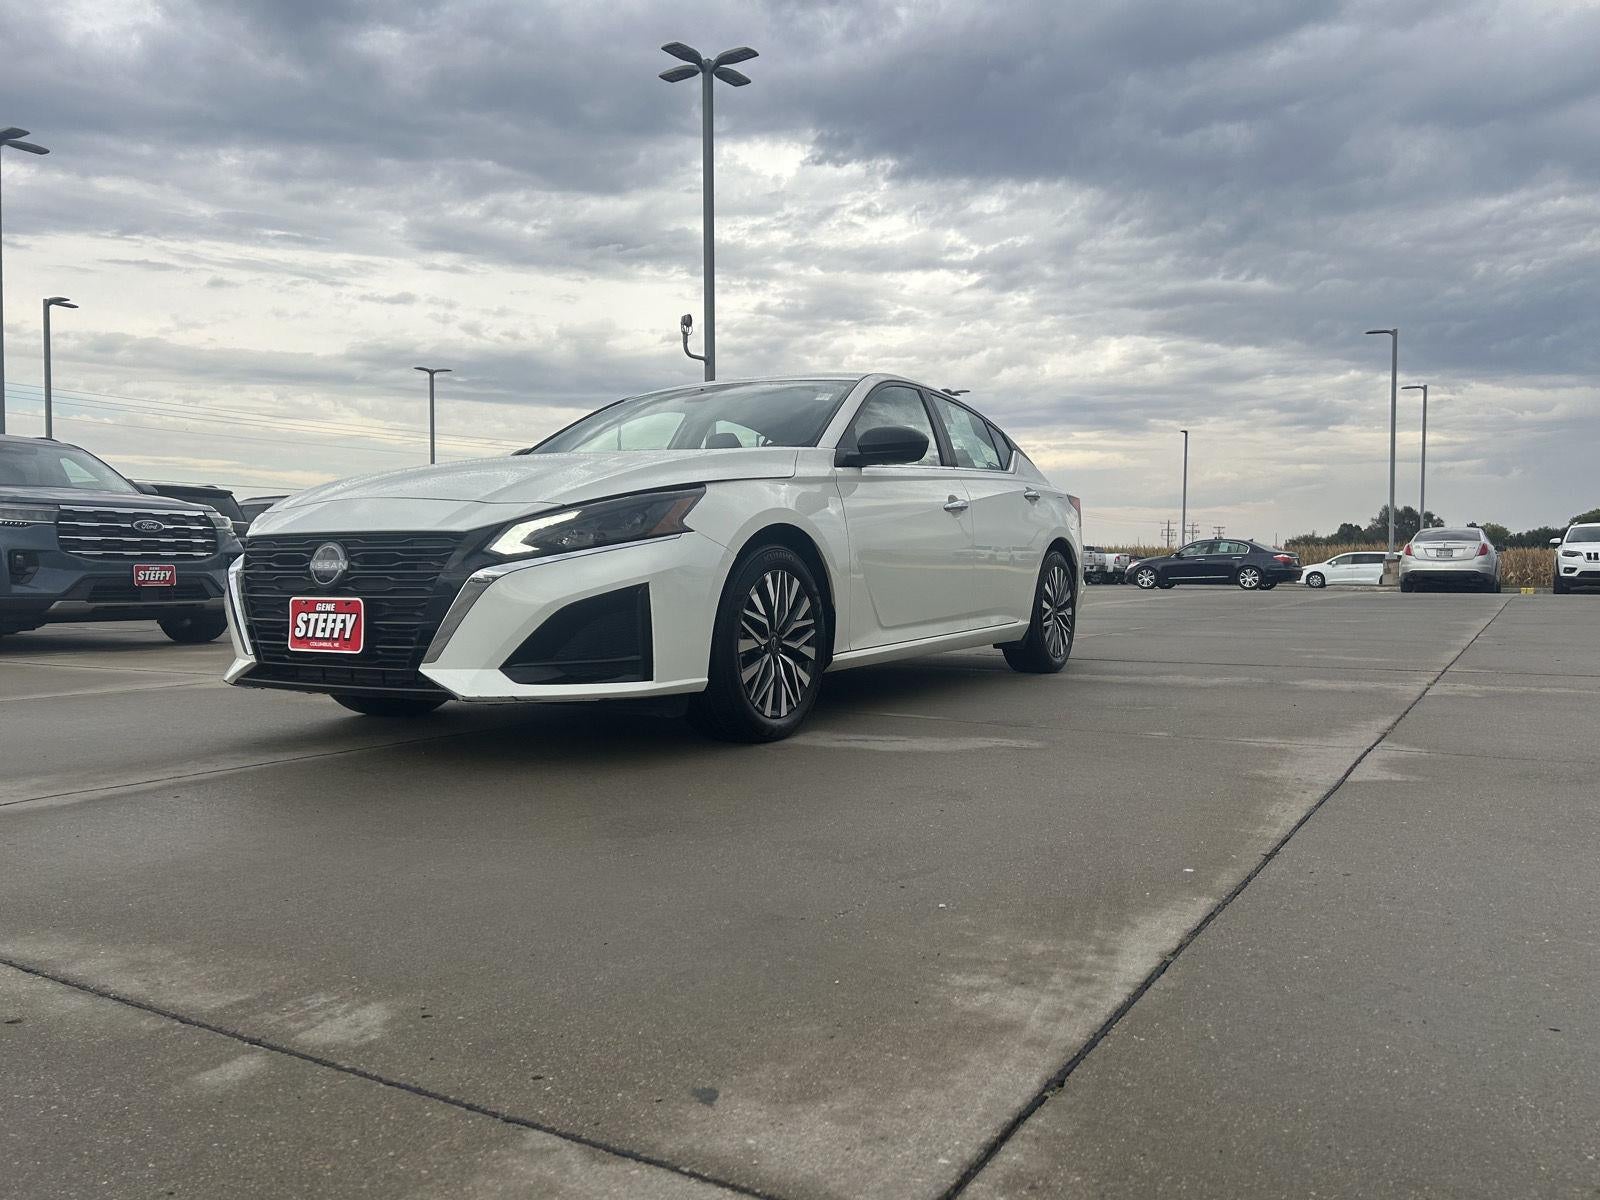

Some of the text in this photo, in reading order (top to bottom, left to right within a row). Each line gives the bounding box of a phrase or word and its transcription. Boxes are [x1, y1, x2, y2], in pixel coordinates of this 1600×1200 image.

[137, 570, 172, 580] STEFFY
[316, 603, 336, 611] GENE
[294, 612, 356, 638] STEFFY
